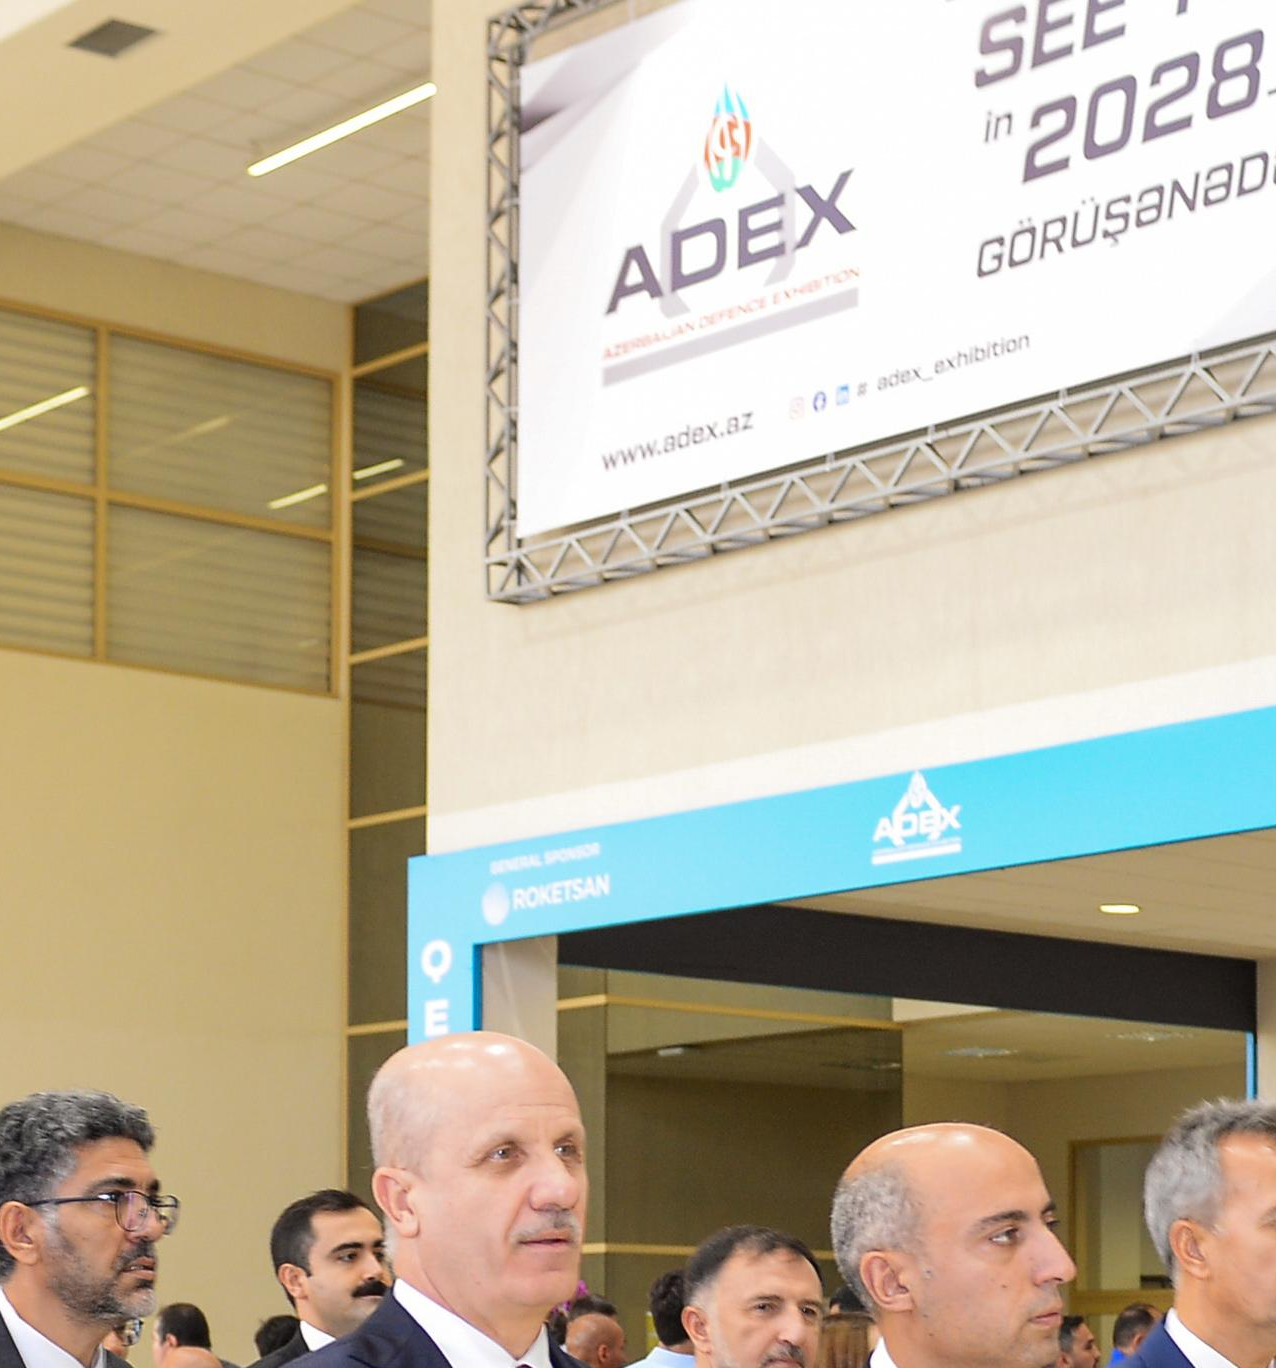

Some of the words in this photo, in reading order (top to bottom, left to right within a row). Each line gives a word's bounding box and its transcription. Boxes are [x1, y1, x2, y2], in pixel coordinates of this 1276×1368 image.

[984, 110, 1014, 143] in
[605, 167, 858, 316] ADEX
[602, 322, 696, 360] AZERBAIJAN
[699, 297, 768, 329] DEFENCE
[773, 267, 861, 305] EXHIBITION
[877, 332, 1031, 392] adex_exhibition
[601, 409, 755, 472] www.adex.az
[872, 804, 962, 843] ADEX
[489, 854, 542, 876] GENERAL
[544, 842, 601, 866] SPONSOR
[512, 873, 611, 910] ROKETSAN
